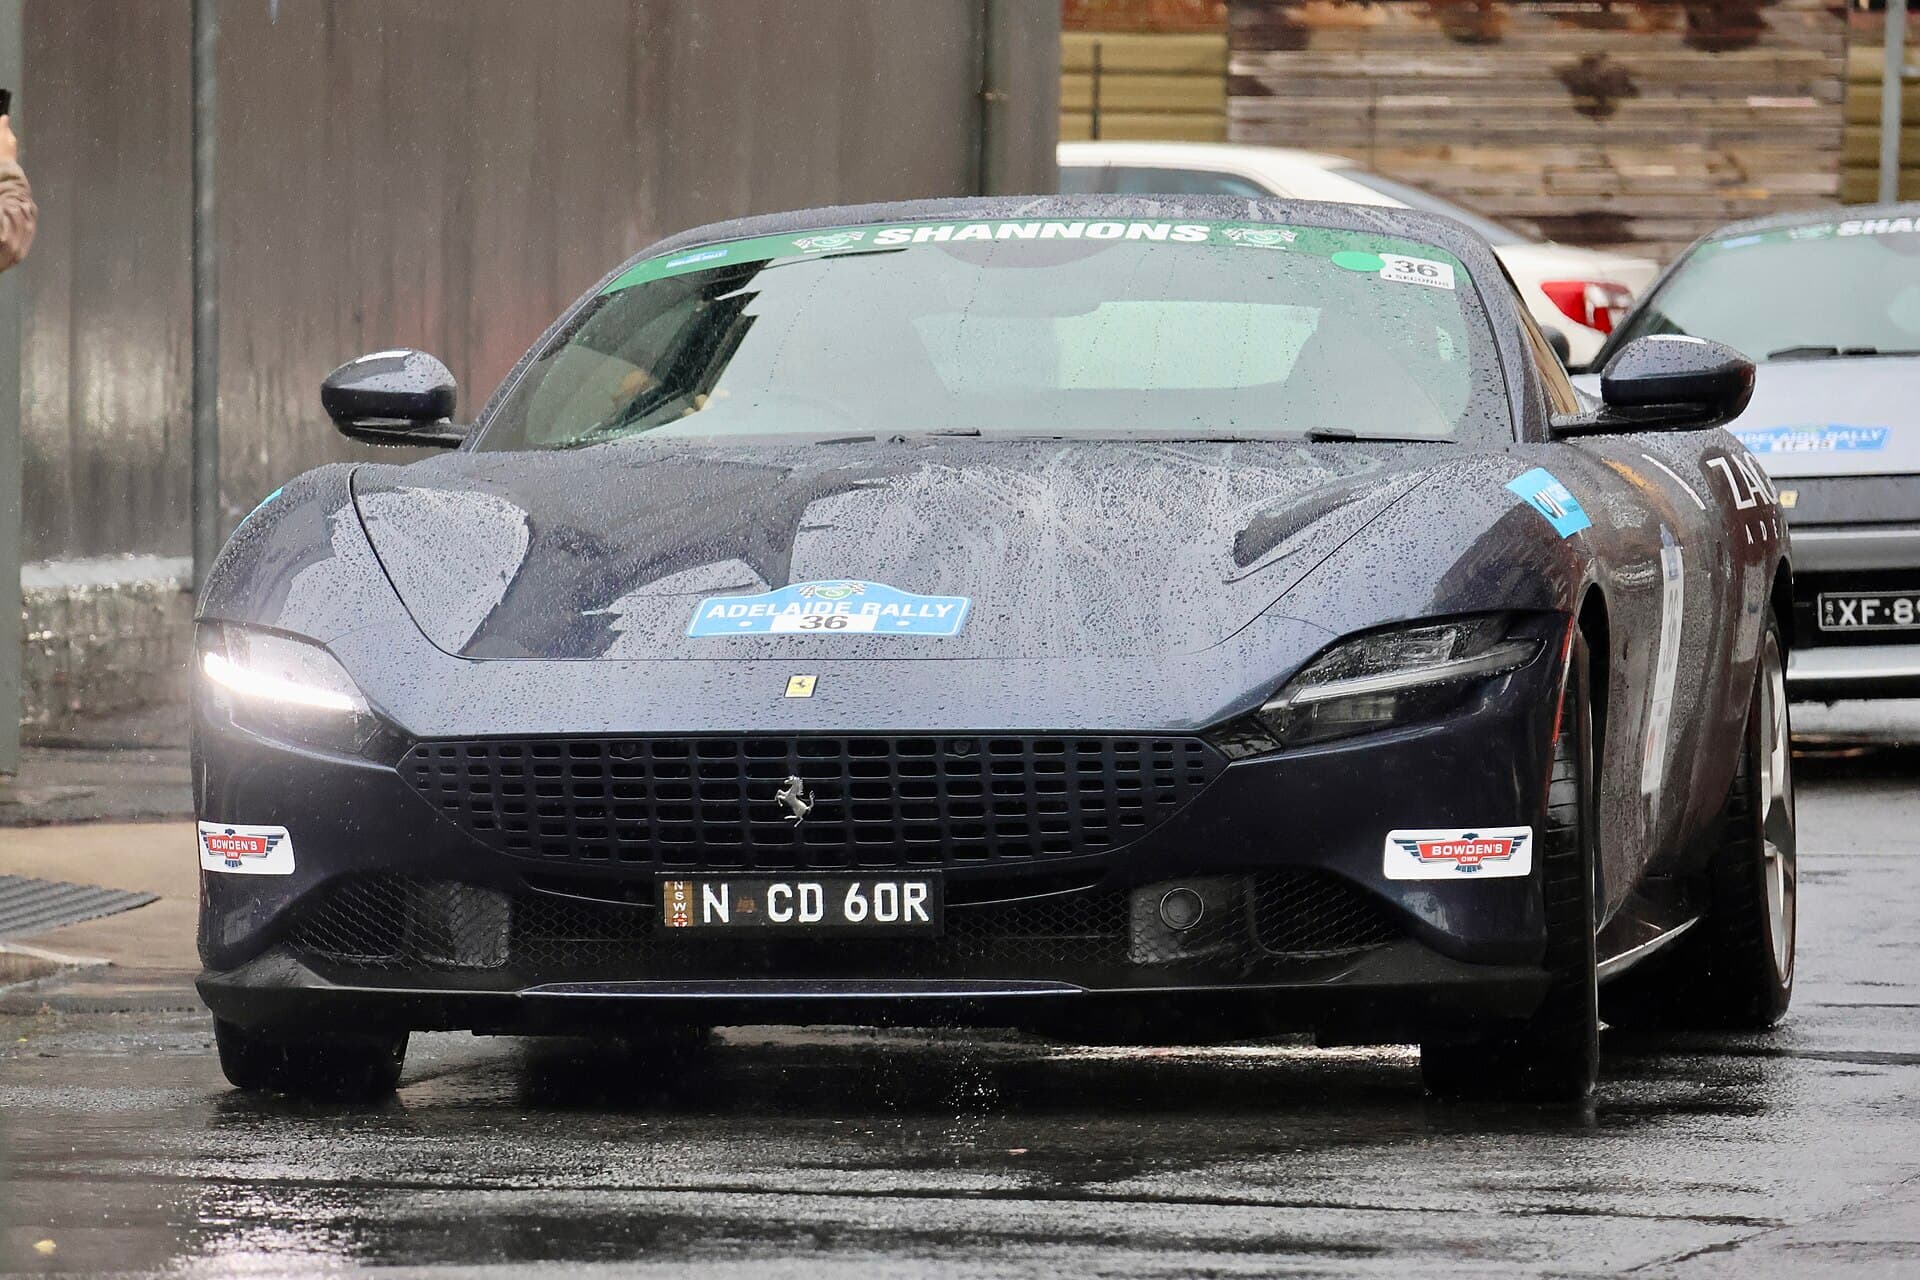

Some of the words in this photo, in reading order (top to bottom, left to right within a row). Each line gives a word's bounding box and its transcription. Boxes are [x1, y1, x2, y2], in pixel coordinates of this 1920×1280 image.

[873, 222, 1210, 245] SHANNONS
[1837, 218, 1920, 236] SHA
[1393, 259, 1439, 278] 36
[1824, 429, 1882, 442] RALLY
[706, 601, 850, 618] ADELAIDE
[859, 602, 955, 618] RALLY
[799, 615, 849, 630] 36
[211, 839, 258, 851] BOWDEN'S
[1431, 843, 1503, 856] BOWDEN'S
[1460, 855, 1478, 863] OWN
[672, 881, 687, 912] NSW
[702, 883, 730, 923] N
[767, 883, 824, 923] CD
[844, 882, 930, 922] 60R
